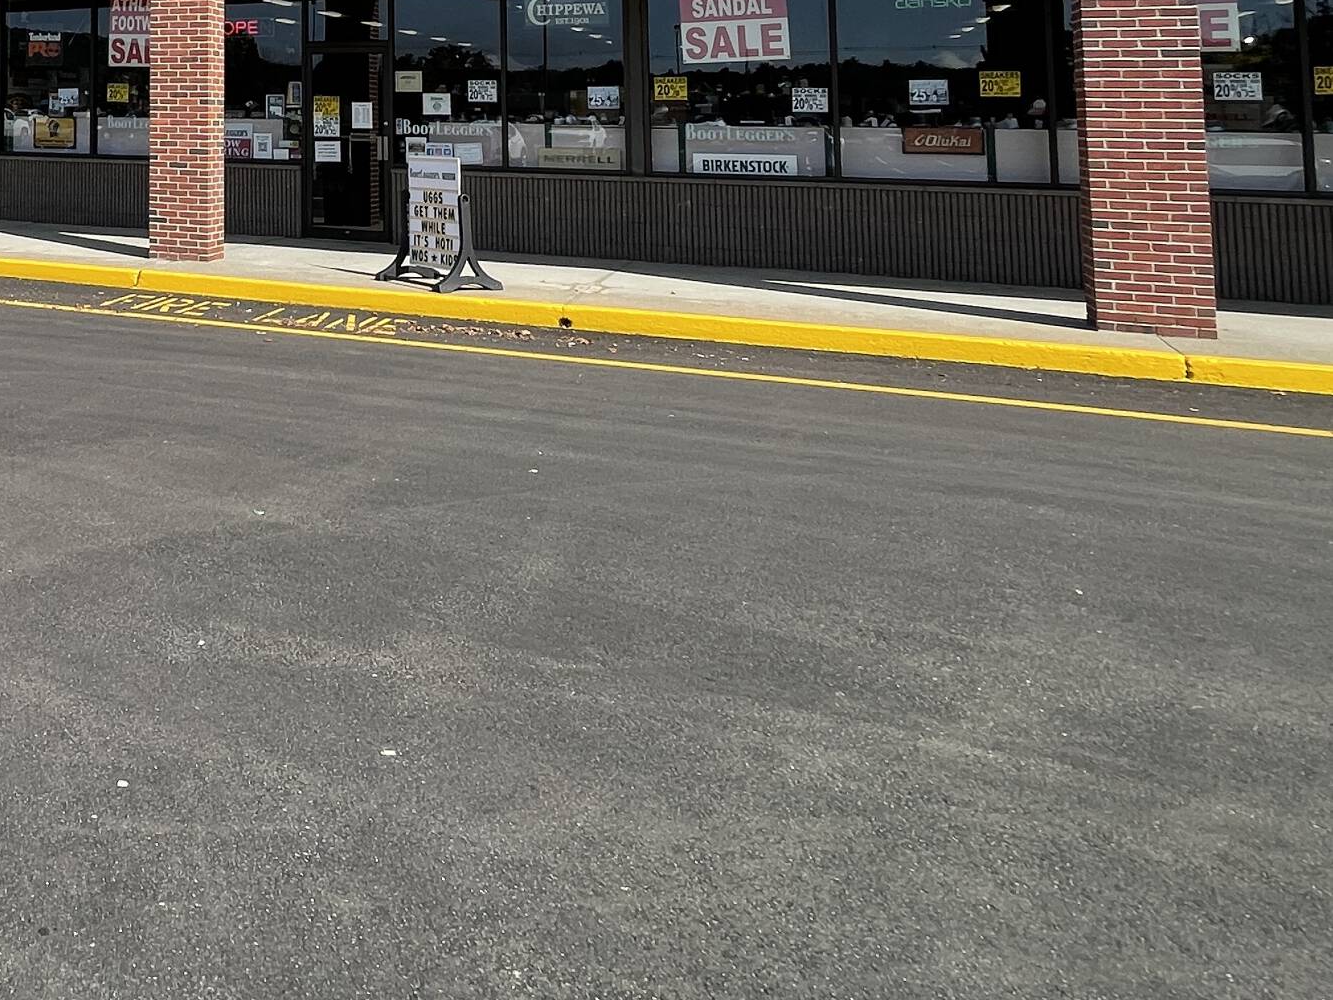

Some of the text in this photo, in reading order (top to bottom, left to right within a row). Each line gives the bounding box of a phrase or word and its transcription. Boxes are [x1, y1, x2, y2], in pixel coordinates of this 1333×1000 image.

[686, 23, 785, 59] SALE
[658, 85, 680, 96] 20%
[982, 80, 1003, 92] 20%
[1215, 84, 1242, 97] 20%
[912, 89, 938, 101] 25%
[793, 97, 814, 111] 20%
[403, 118, 494, 136] BOOTLEGGER'S
[702, 159, 788, 174] BIRKENSTOCK
[423, 191, 443, 204] UGGS
[414, 205, 455, 221] GET THEM
[421, 221, 446, 235] WHILE
[414, 235, 429, 248] IT'S
[100, 294, 232, 316] FIRE
